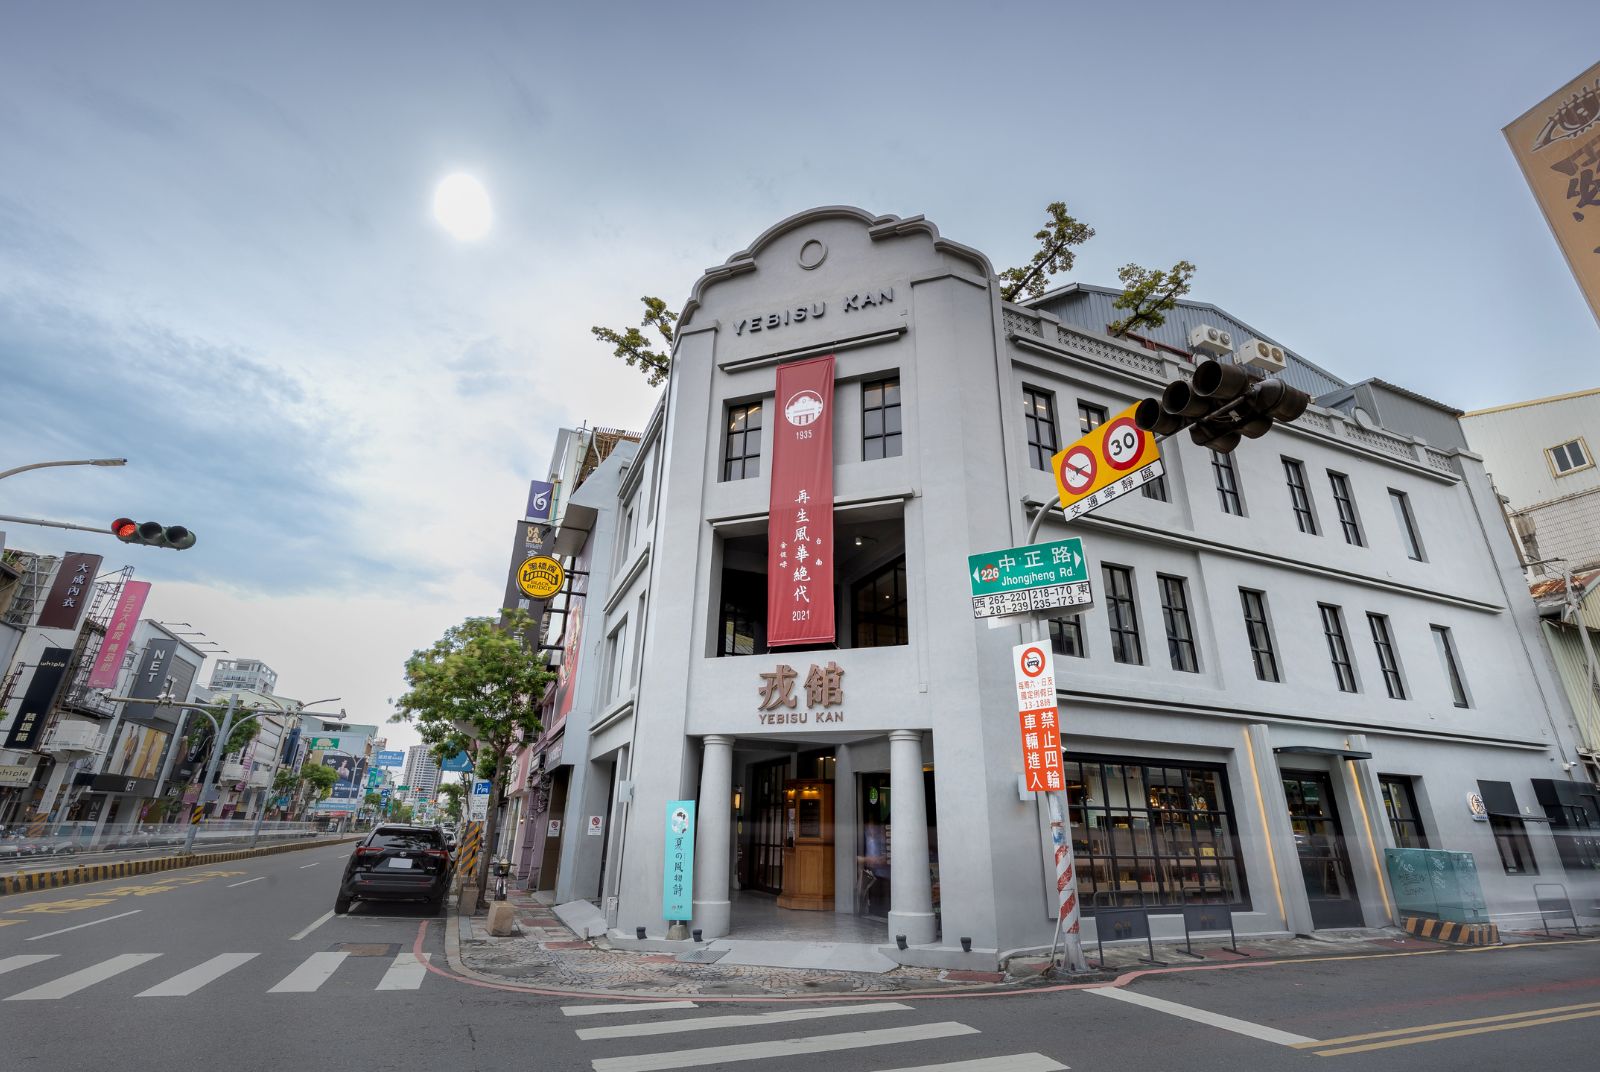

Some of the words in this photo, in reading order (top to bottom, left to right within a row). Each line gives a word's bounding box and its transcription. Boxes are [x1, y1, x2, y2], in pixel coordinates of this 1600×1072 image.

[732, 301, 826, 336] YEBISU
[844, 287, 894, 313] KAN
[796, 430, 812, 440] 1935
[1110, 432, 1135, 456] 30
[1070, 465, 1155, 518] 交通寧靜區
[793, 489, 811, 603] 再生風華絕代
[998, 546, 1072, 572] 中正路
[981, 567, 999, 581] 226
[1001, 570, 1055, 587] Jhongjheng
[1060, 566, 1076, 578] Rd.
[974, 598, 986, 609] 西
[988, 592, 1027, 606] 262-220
[1032, 585, 1072, 599] 218-170
[1077, 583, 1089, 595] 東
[989, 602, 1029, 615] 281-239
[1033, 596, 1074, 609] 235-173
[792, 609, 811, 621] 2021
[148, 649, 166, 682] NET
[758, 661, 845, 711] 戎館
[758, 713, 808, 725] YEBISU
[816, 711, 844, 723] KAN
[1024, 713, 1043, 789] 車輛進入
[1041, 711, 1060, 789] 禁止四輪
